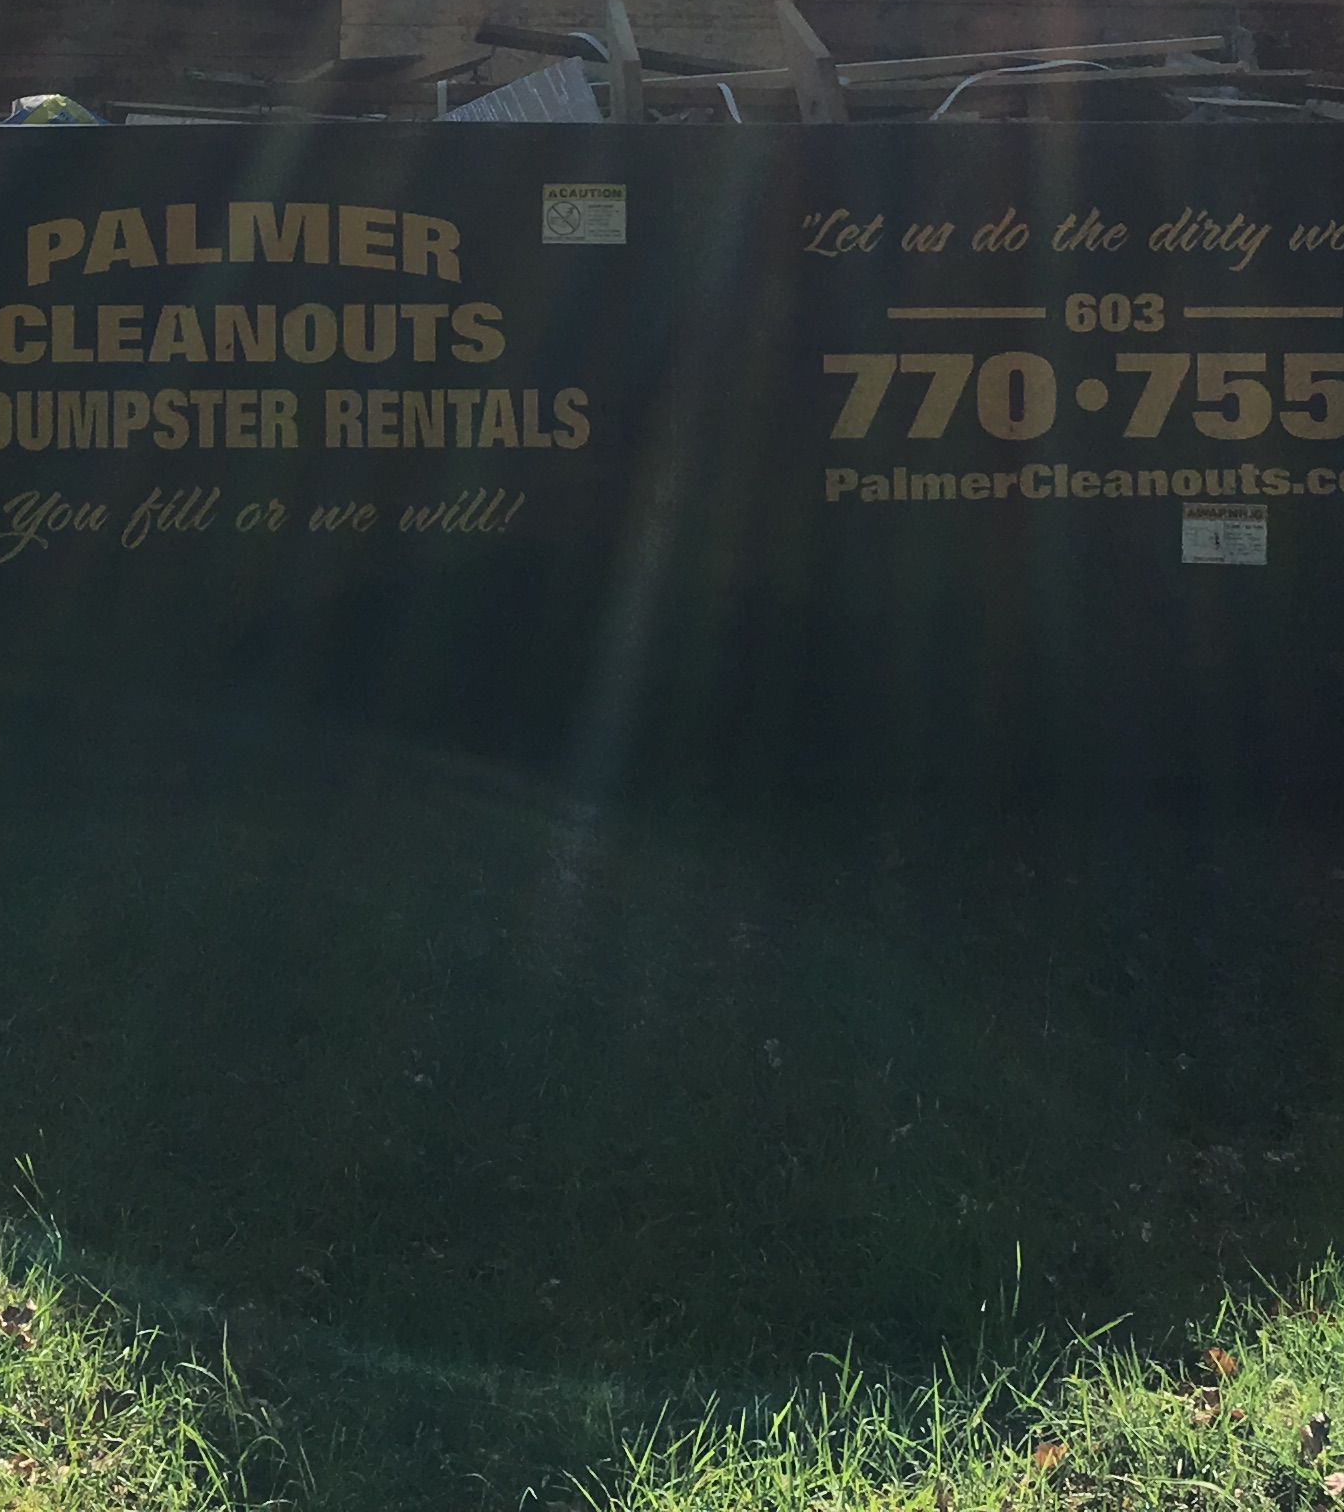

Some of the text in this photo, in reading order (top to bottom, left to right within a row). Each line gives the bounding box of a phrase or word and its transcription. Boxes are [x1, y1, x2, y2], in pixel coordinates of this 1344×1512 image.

[559, 188, 623, 198] CAUTION
[27, 201, 461, 286] PALMER
[800, 207, 882, 258] "Let
[901, 221, 952, 254] us
[971, 207, 1030, 254] do
[1052, 207, 1129, 253] the
[1148, 207, 1272, 272] dirty
[1064, 292, 1166, 333] 603
[324, 387, 591, 450] RENTALS
[121, 486, 223, 550] fill
[236, 498, 290, 533] or
[309, 501, 377, 533] we
[399, 487, 525, 534] will!
